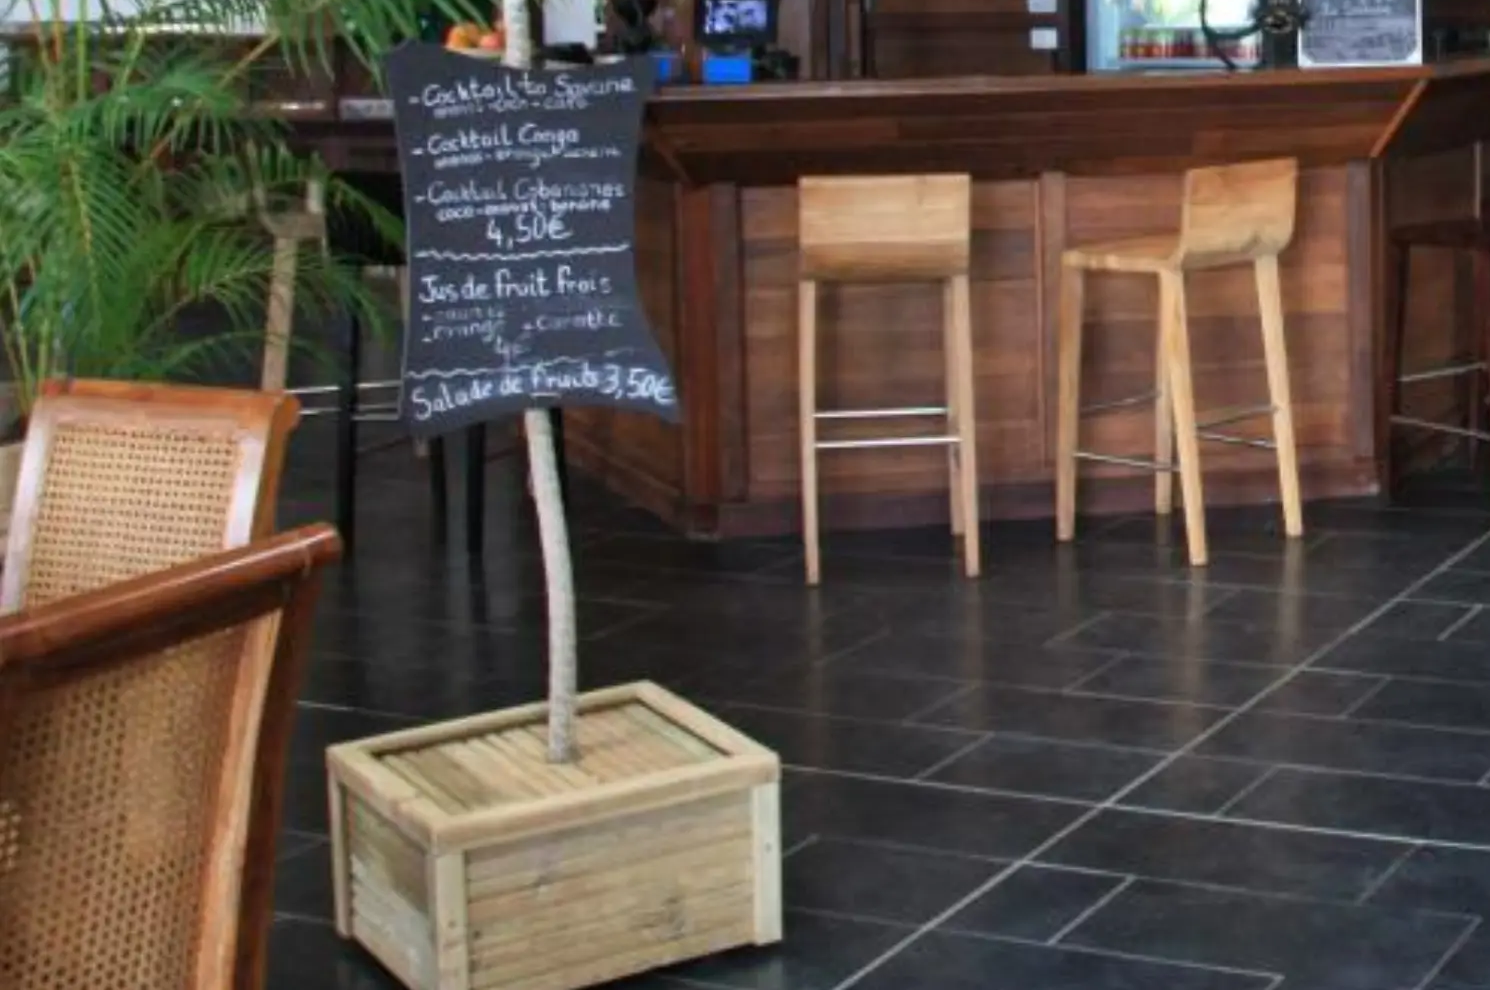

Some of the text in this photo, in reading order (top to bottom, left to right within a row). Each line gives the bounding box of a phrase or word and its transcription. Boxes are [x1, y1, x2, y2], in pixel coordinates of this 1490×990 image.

[418, 274, 460, 304] Jus
[460, 273, 492, 300] de
[494, 267, 552, 299] fruit
[411, 376, 494, 422] Salade
